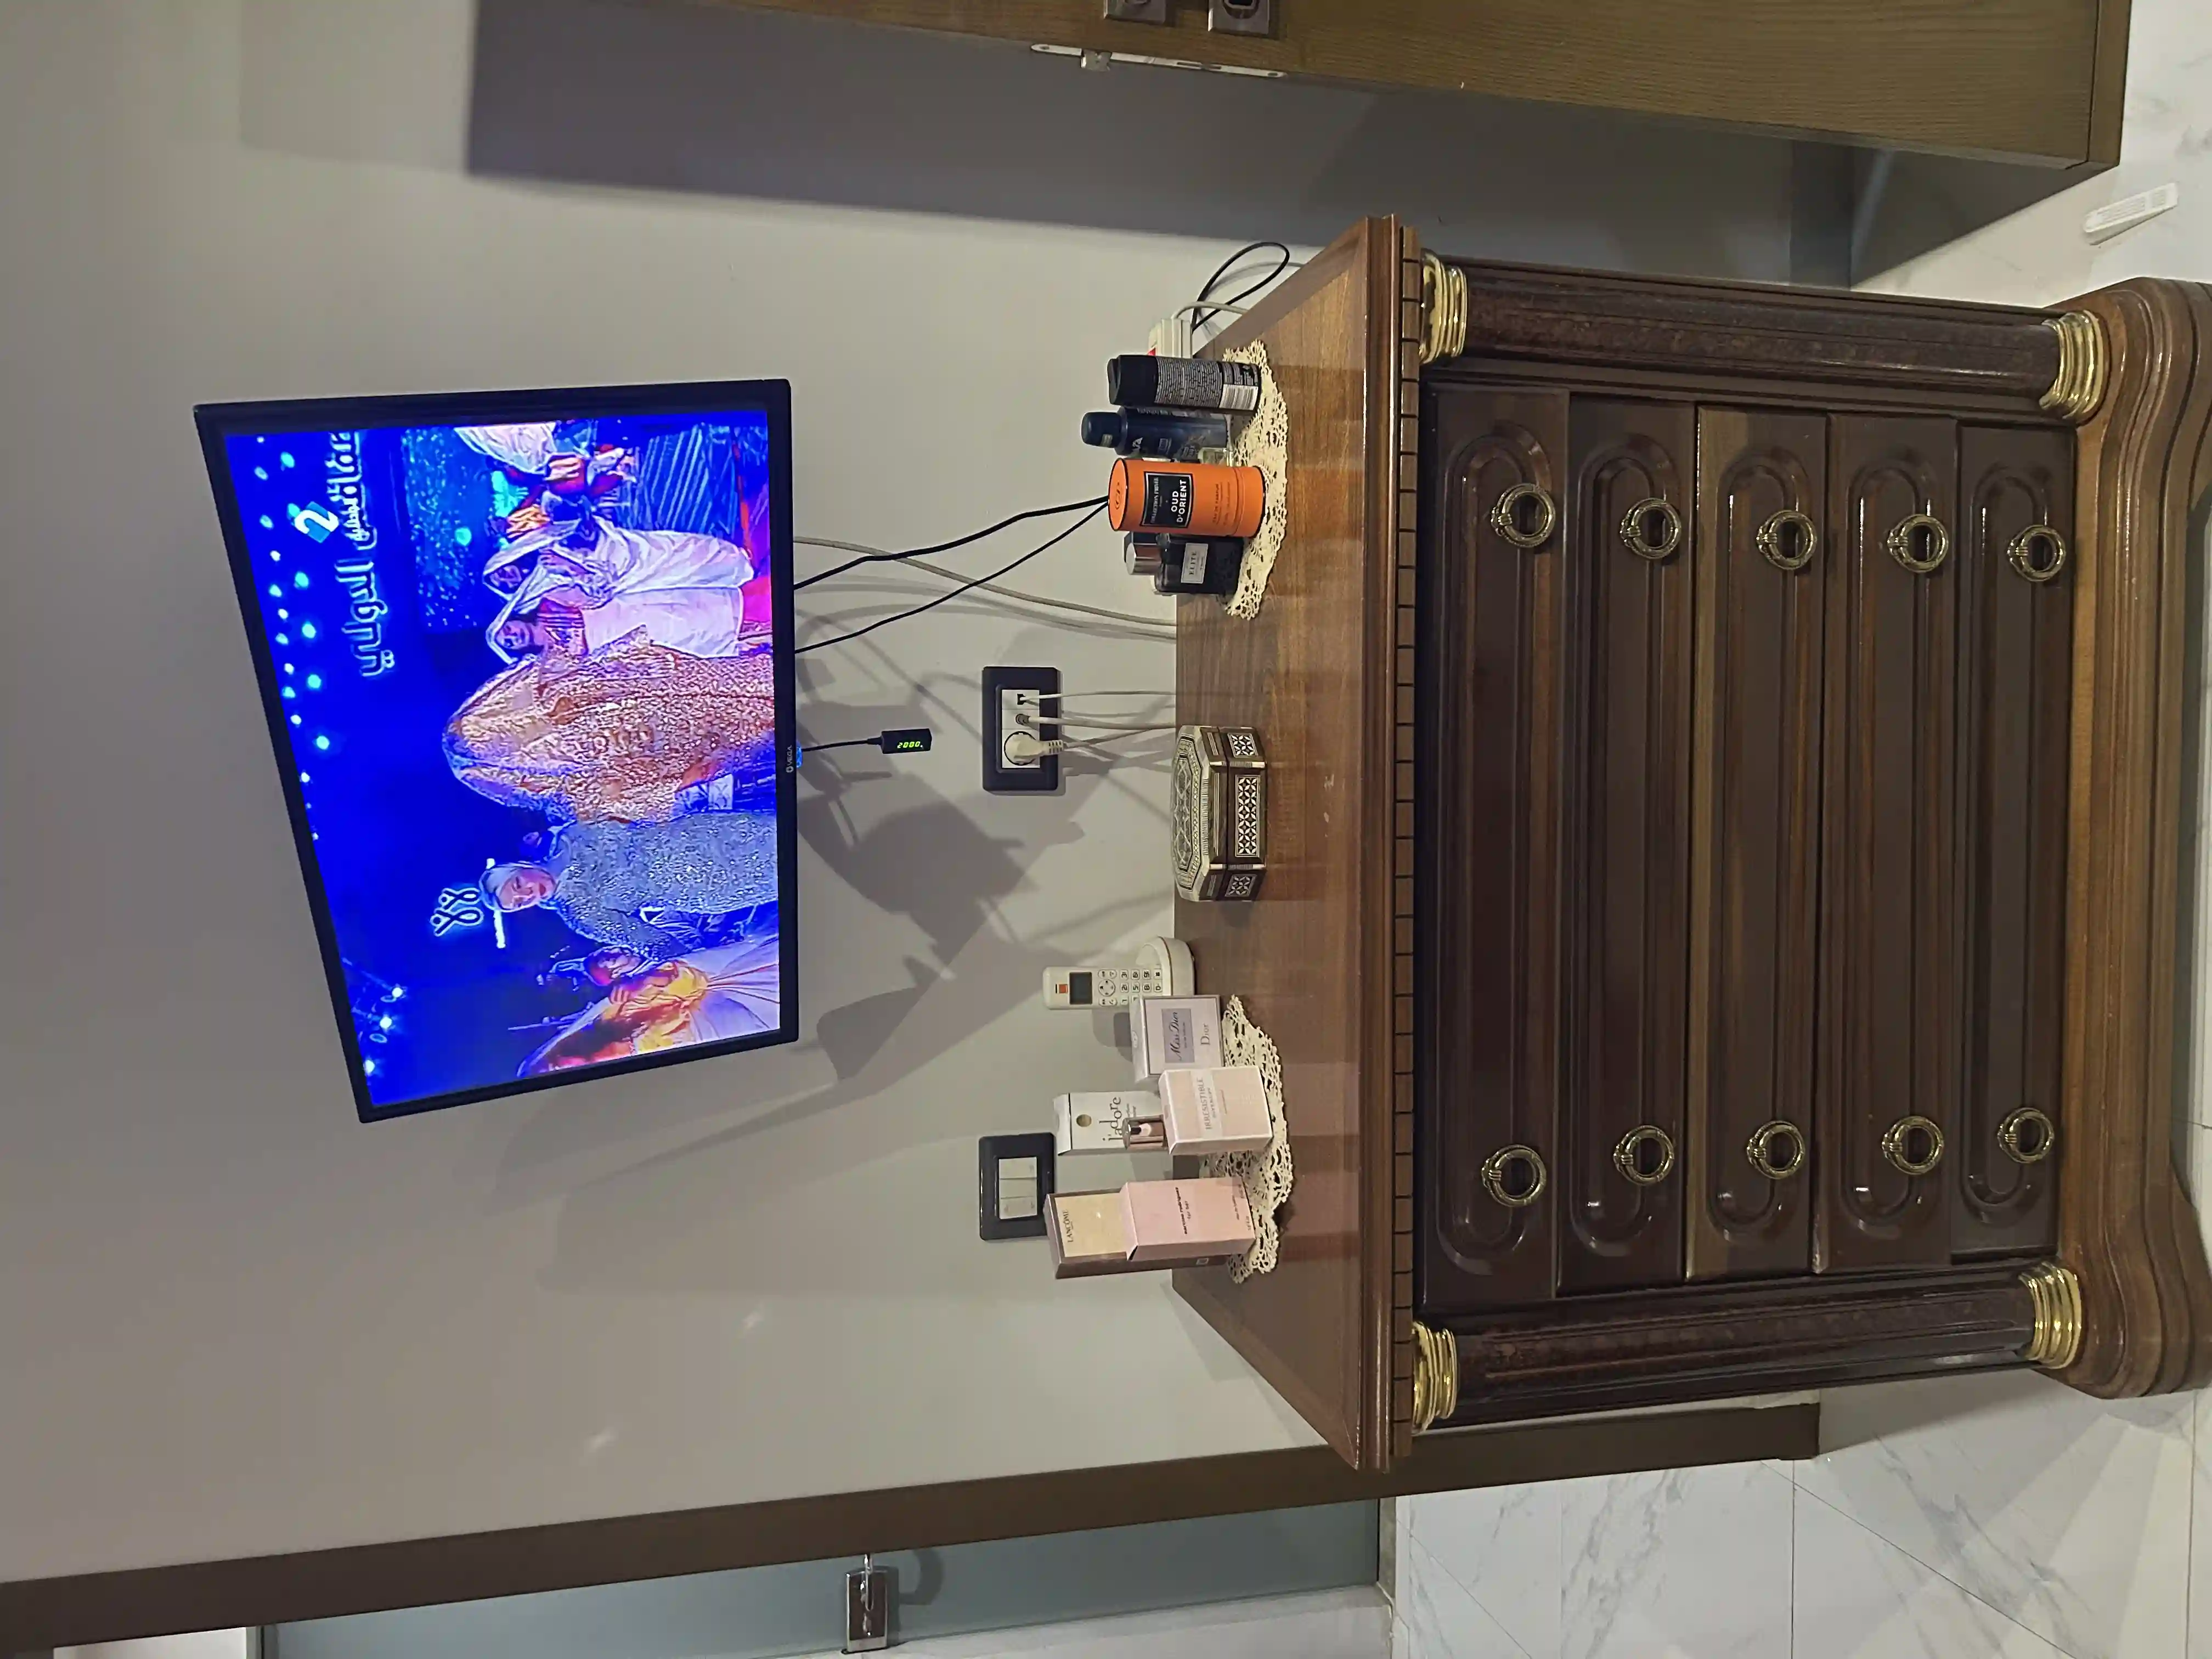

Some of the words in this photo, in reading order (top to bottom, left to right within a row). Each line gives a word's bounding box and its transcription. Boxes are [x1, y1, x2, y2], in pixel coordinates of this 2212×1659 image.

[1171, 490, 1179, 512] OUD
[1176, 479, 1187, 522] D'ORIENT
[1168, 1011, 1180, 1033] Dior
[1199, 1022, 1211, 1045] Dior
[1169, 1034, 1182, 1060] Miss
[1196, 1076, 1213, 1129] IRRESISTIBLE
